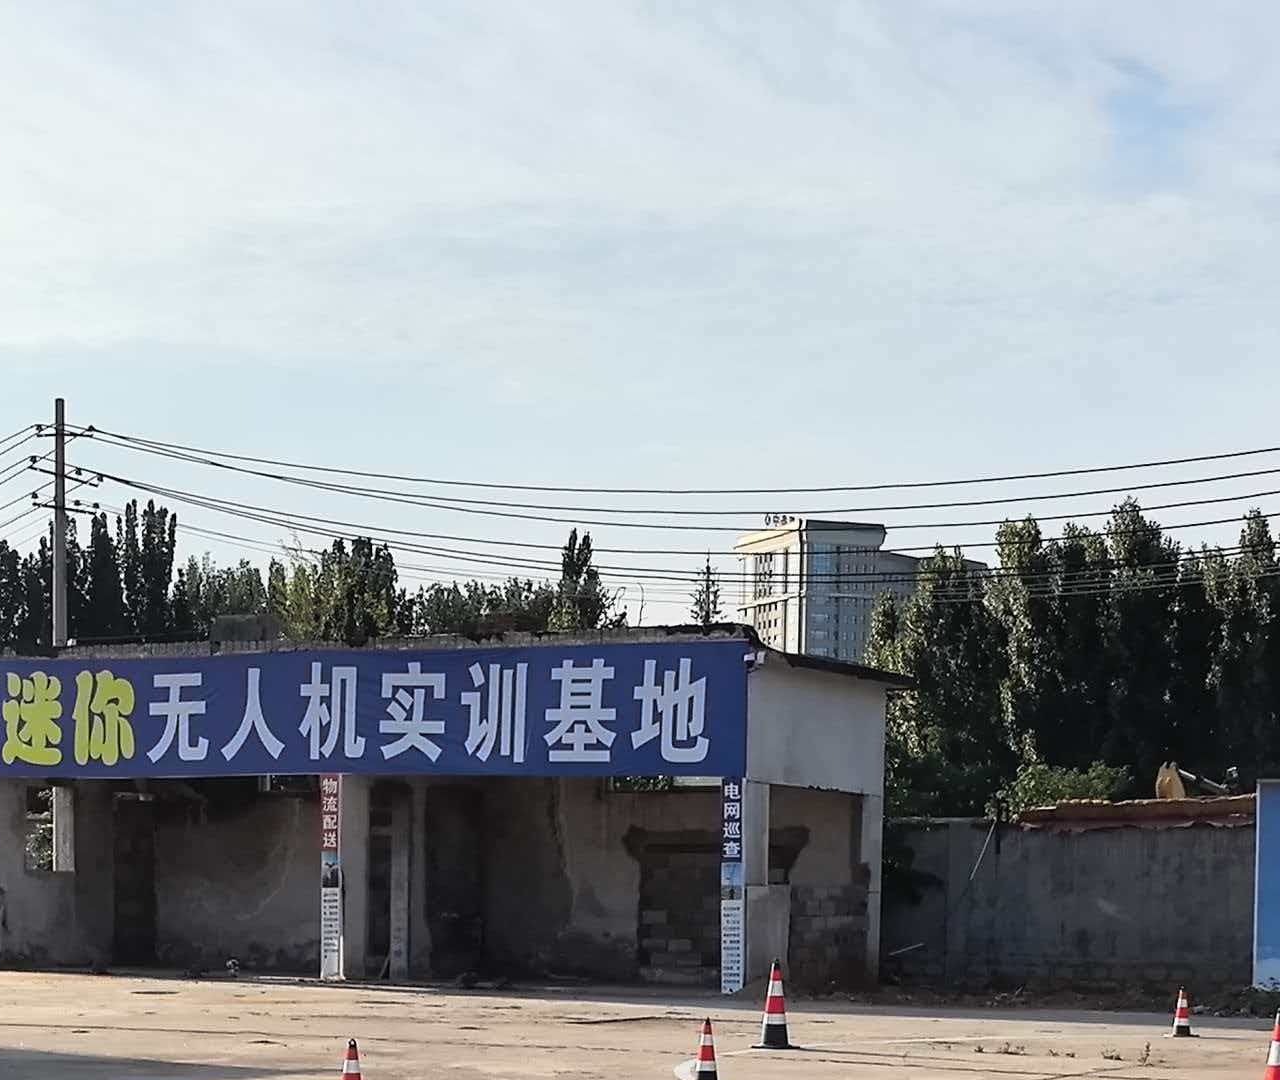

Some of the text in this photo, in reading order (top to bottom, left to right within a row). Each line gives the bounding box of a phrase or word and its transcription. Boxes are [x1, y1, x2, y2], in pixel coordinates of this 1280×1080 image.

[2, 658, 710, 766] 迷你无人机实训基地
[322, 778, 338, 848] 物流配送
[723, 783, 741, 858] 电网巡查
